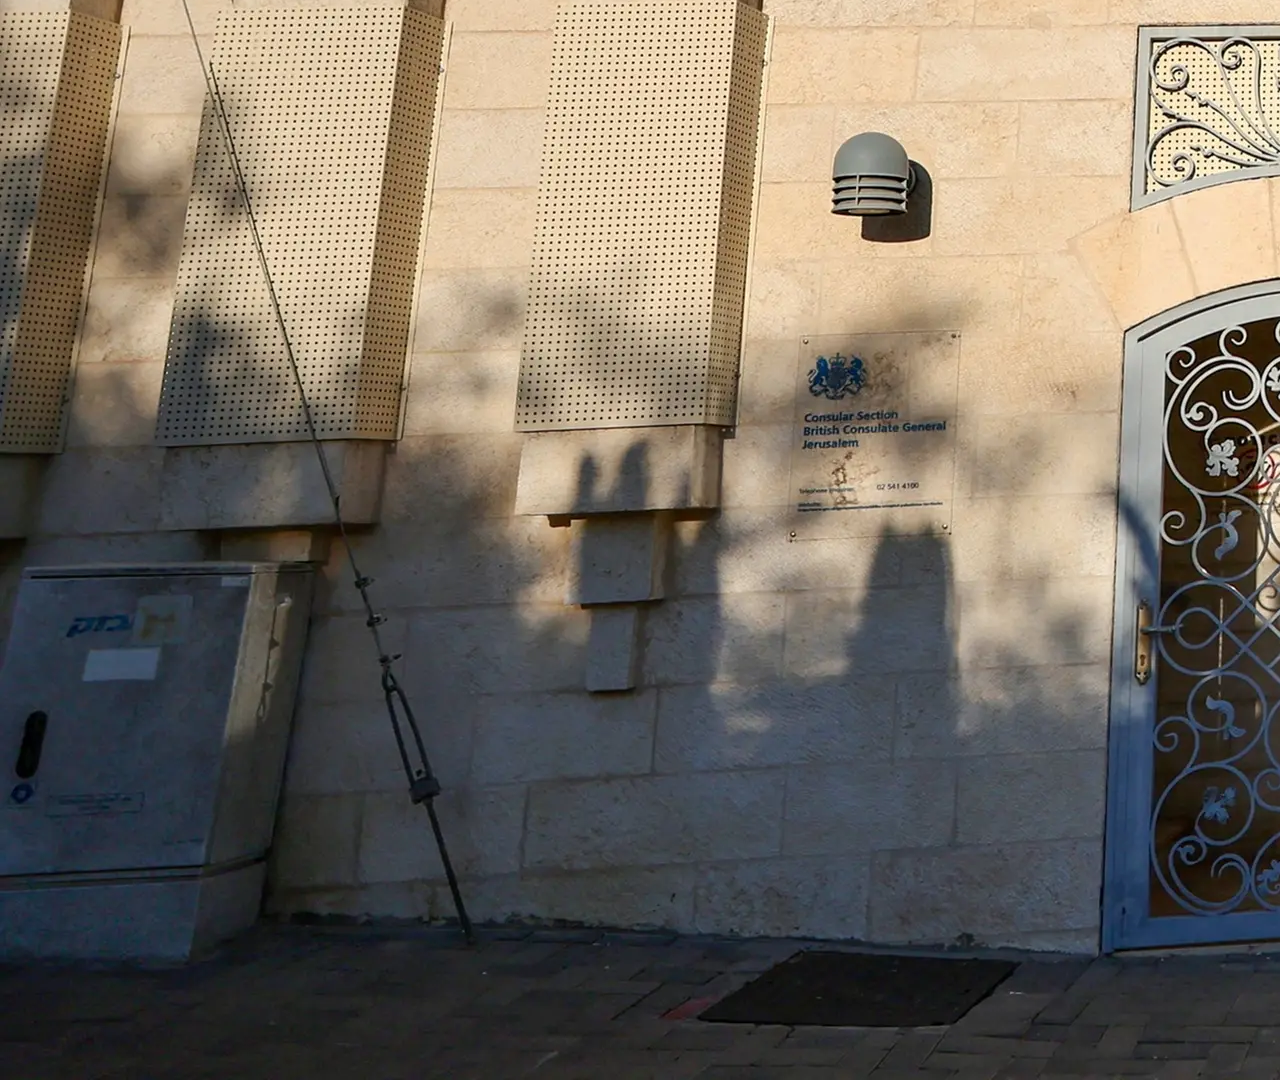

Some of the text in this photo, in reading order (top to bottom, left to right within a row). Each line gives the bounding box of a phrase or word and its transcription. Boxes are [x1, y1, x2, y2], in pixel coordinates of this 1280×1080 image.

[804, 410, 898, 423] Consular Section
[803, 421, 946, 436] British Consulate General
[802, 438, 859, 450] Jerusalem
